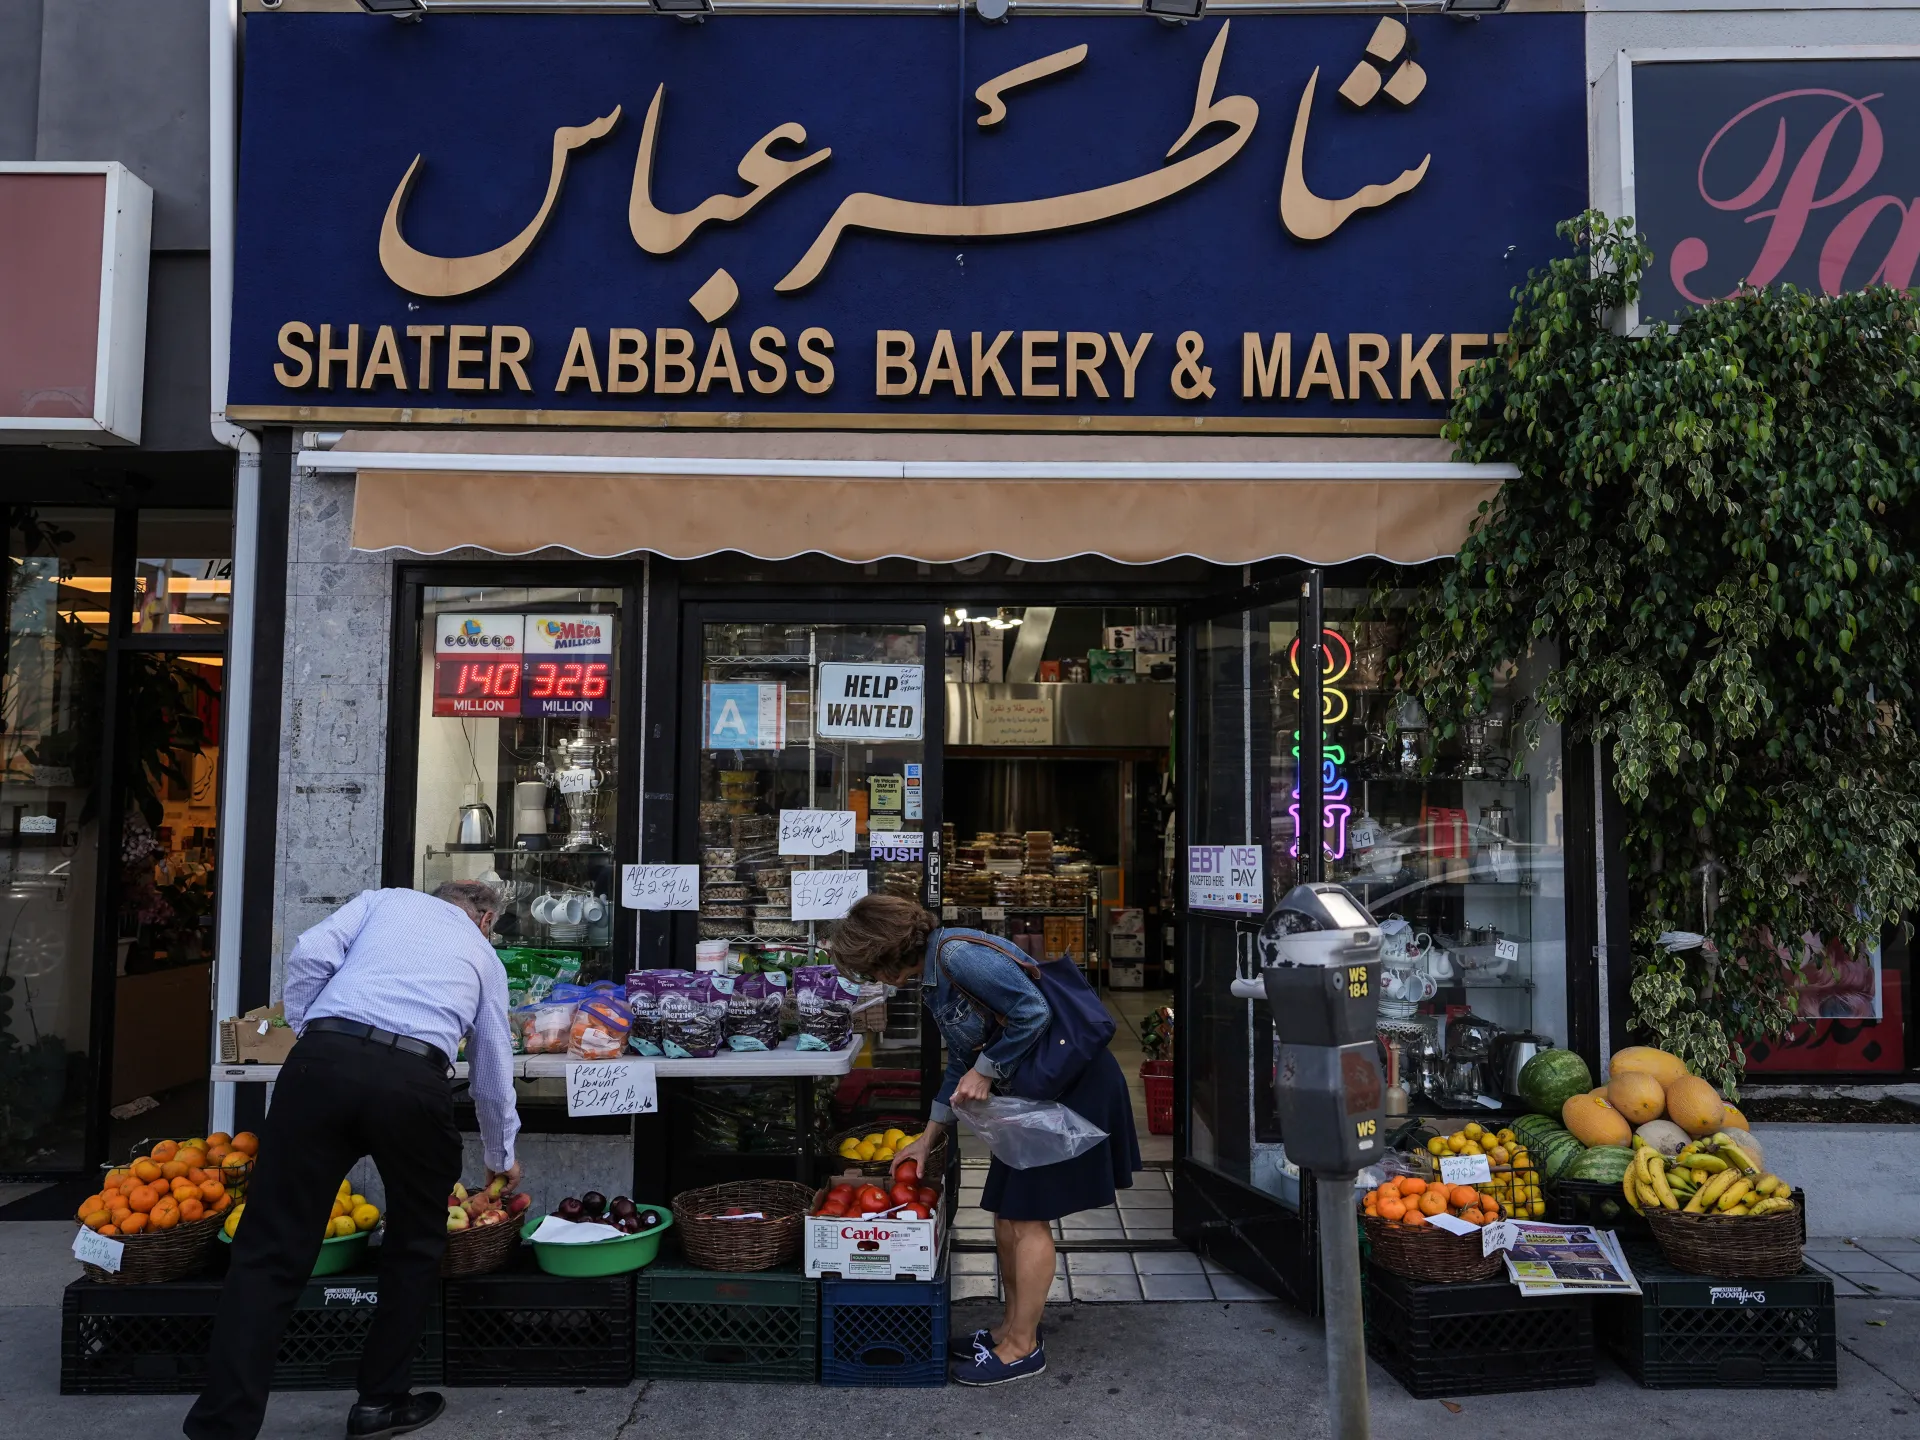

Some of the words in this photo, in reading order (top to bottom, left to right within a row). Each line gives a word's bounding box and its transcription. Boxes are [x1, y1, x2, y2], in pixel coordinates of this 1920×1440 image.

[379, 82, 832, 324] عباس
[273, 321, 533, 393] SHATER
[555, 326, 835, 395] ABBASS
[876, 329, 1154, 399] BAKERY
[1171, 330, 1216, 400] &
[1242, 331, 1533, 402] MARKE
[558, 622, 601, 639] MEGA
[554, 638, 601, 650] MILLIONS
[457, 664, 520, 695] 140
[533, 664, 607, 696] 326
[844, 675, 898, 698] HELP
[454, 700, 504, 711] MILLION
[543, 700, 593, 712] MILLION
[713, 699, 747, 735] A
[827, 703, 914, 729] WANTED
[560, 772, 584, 788] $249
[782, 825, 814, 841] $2.99
[871, 848, 923, 862] PUSH
[1190, 848, 1224, 873] EBT
[1231, 848, 1256, 866] NRS
[1190, 875, 1211, 886] ACCEPTED
[1213, 876, 1224, 886] HERE
[1231, 869, 1257, 886] PAY
[1349, 967, 1367, 982] WS
[1348, 983, 1368, 998] 184
[631, 1007, 661, 1016] Cherri
[665, 1001, 692, 1012] Sweet
[665, 1011, 697, 1019] herries
[572, 1089, 619, 1109] $2.49
[1356, 1119, 1376, 1137] WS
[841, 1227, 891, 1240] Carlo
[324, 1290, 378, 1305] Driftwood
[1710, 1289, 1765, 1304] Driftwood
